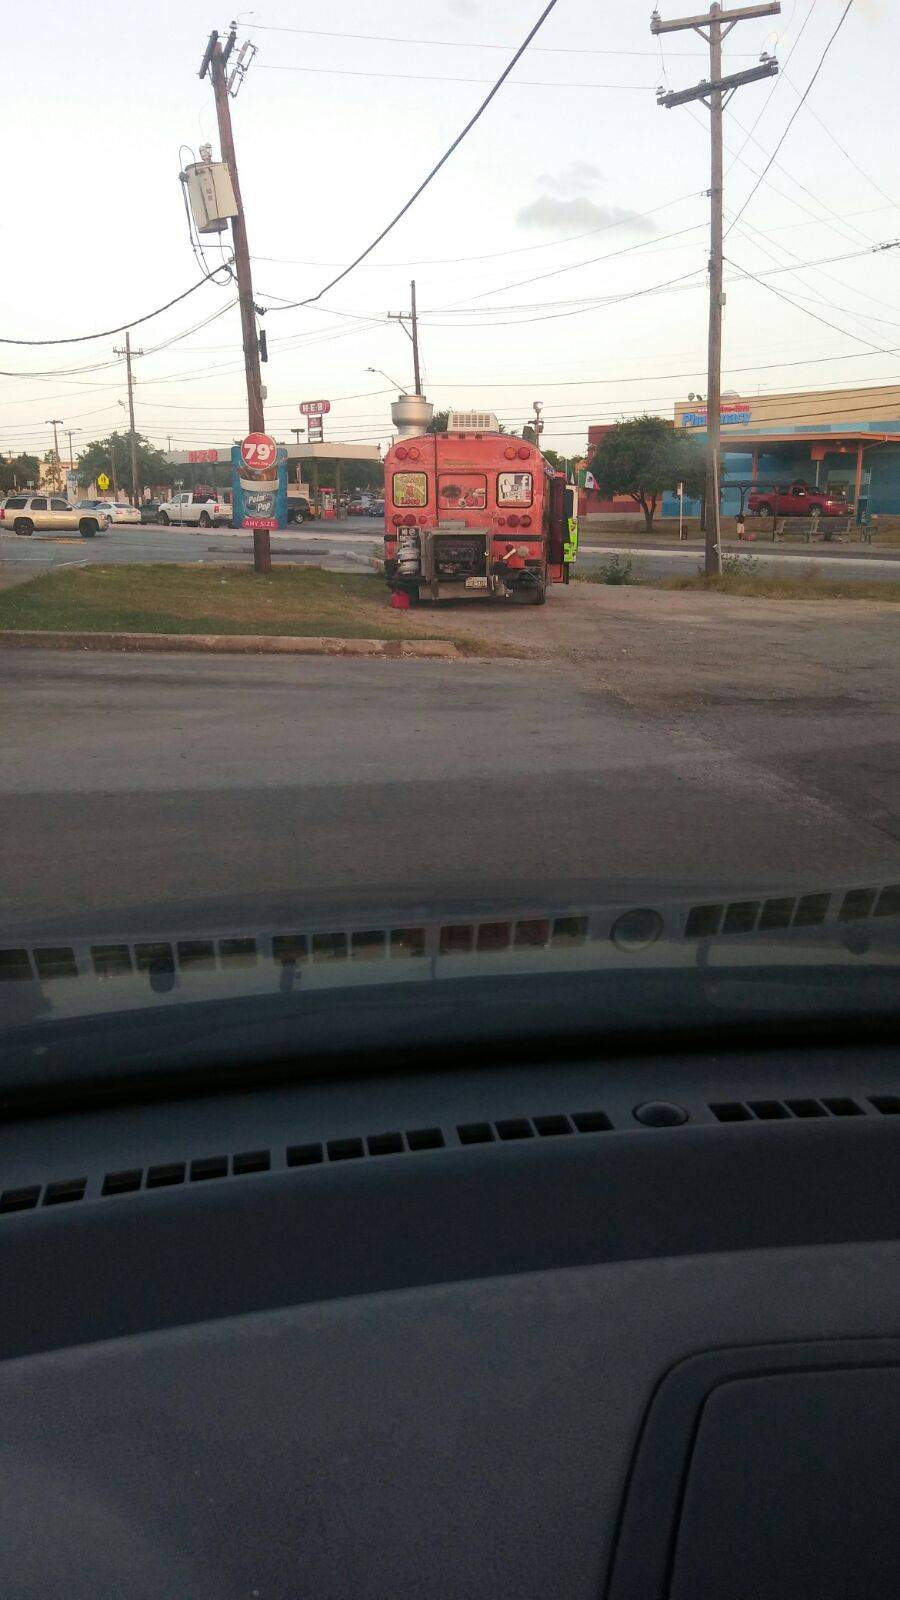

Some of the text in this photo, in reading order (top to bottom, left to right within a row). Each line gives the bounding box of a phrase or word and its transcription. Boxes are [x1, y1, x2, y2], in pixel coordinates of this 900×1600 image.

[682, 412, 751, 426] Phamacy
[248, 494, 267, 504] Polar
[257, 502, 271, 512] Pop
